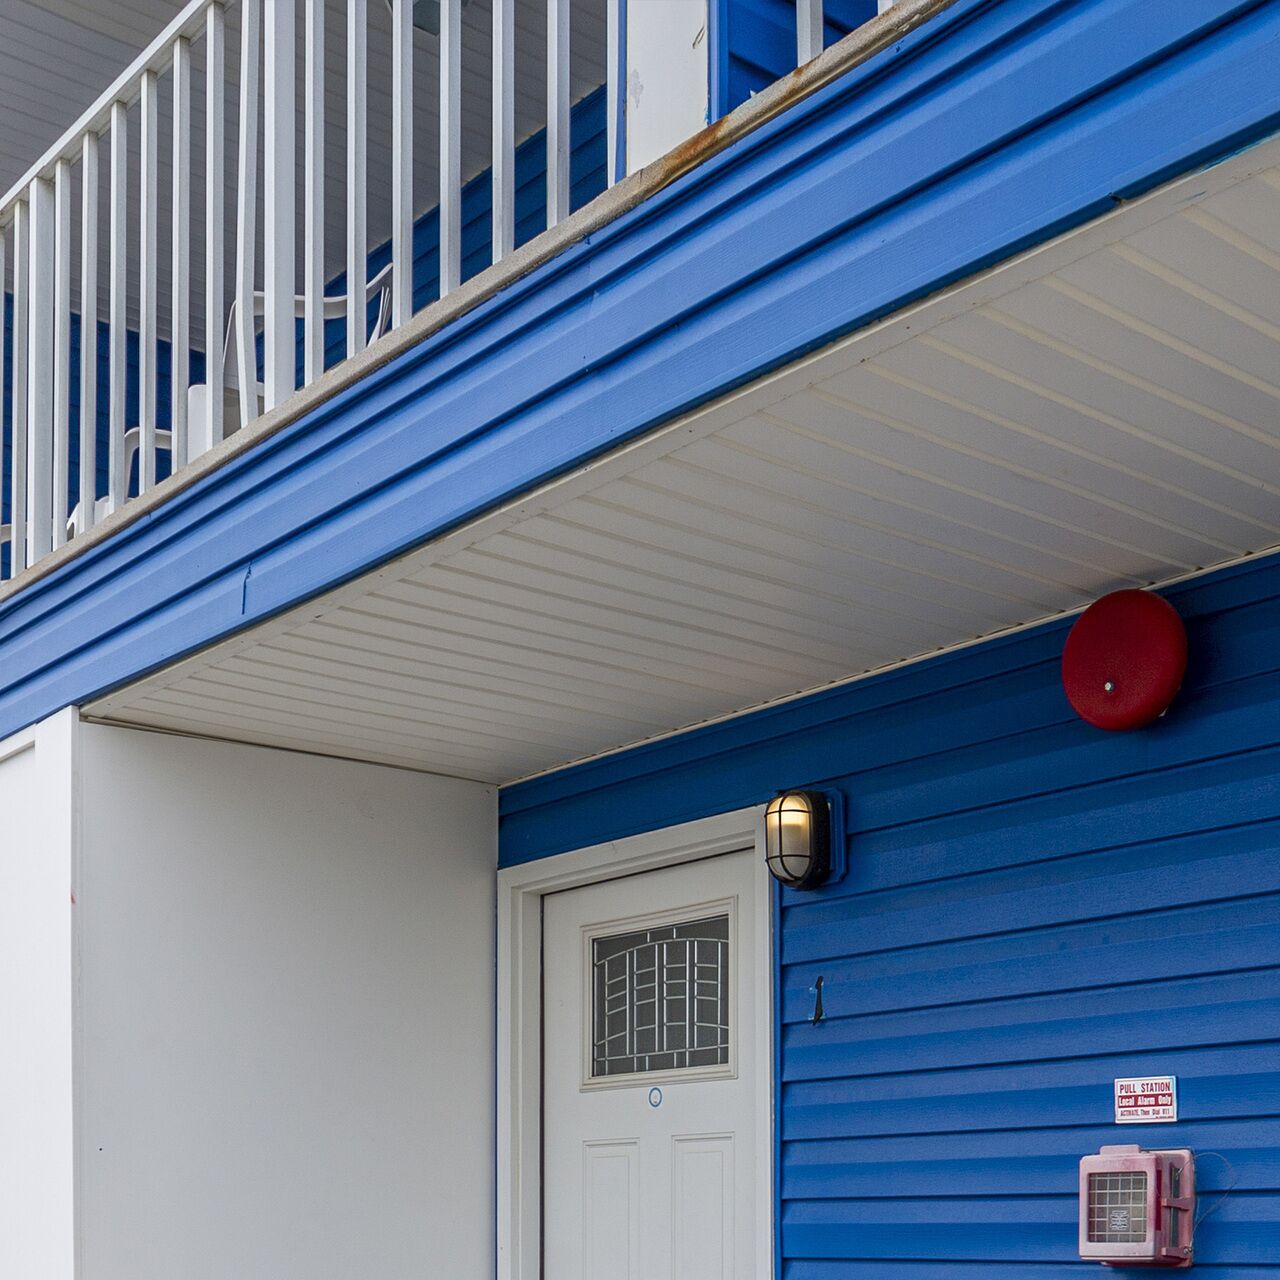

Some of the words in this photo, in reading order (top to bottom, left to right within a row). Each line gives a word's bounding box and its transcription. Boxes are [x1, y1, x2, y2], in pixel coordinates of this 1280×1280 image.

[1120, 1083, 1136, 1094] PULL
[1141, 1081, 1171, 1093] STATION
[1119, 1096, 1135, 1106] Local
[1137, 1096, 1155, 1105] Alarm
[1158, 1094, 1172, 1105] Only
